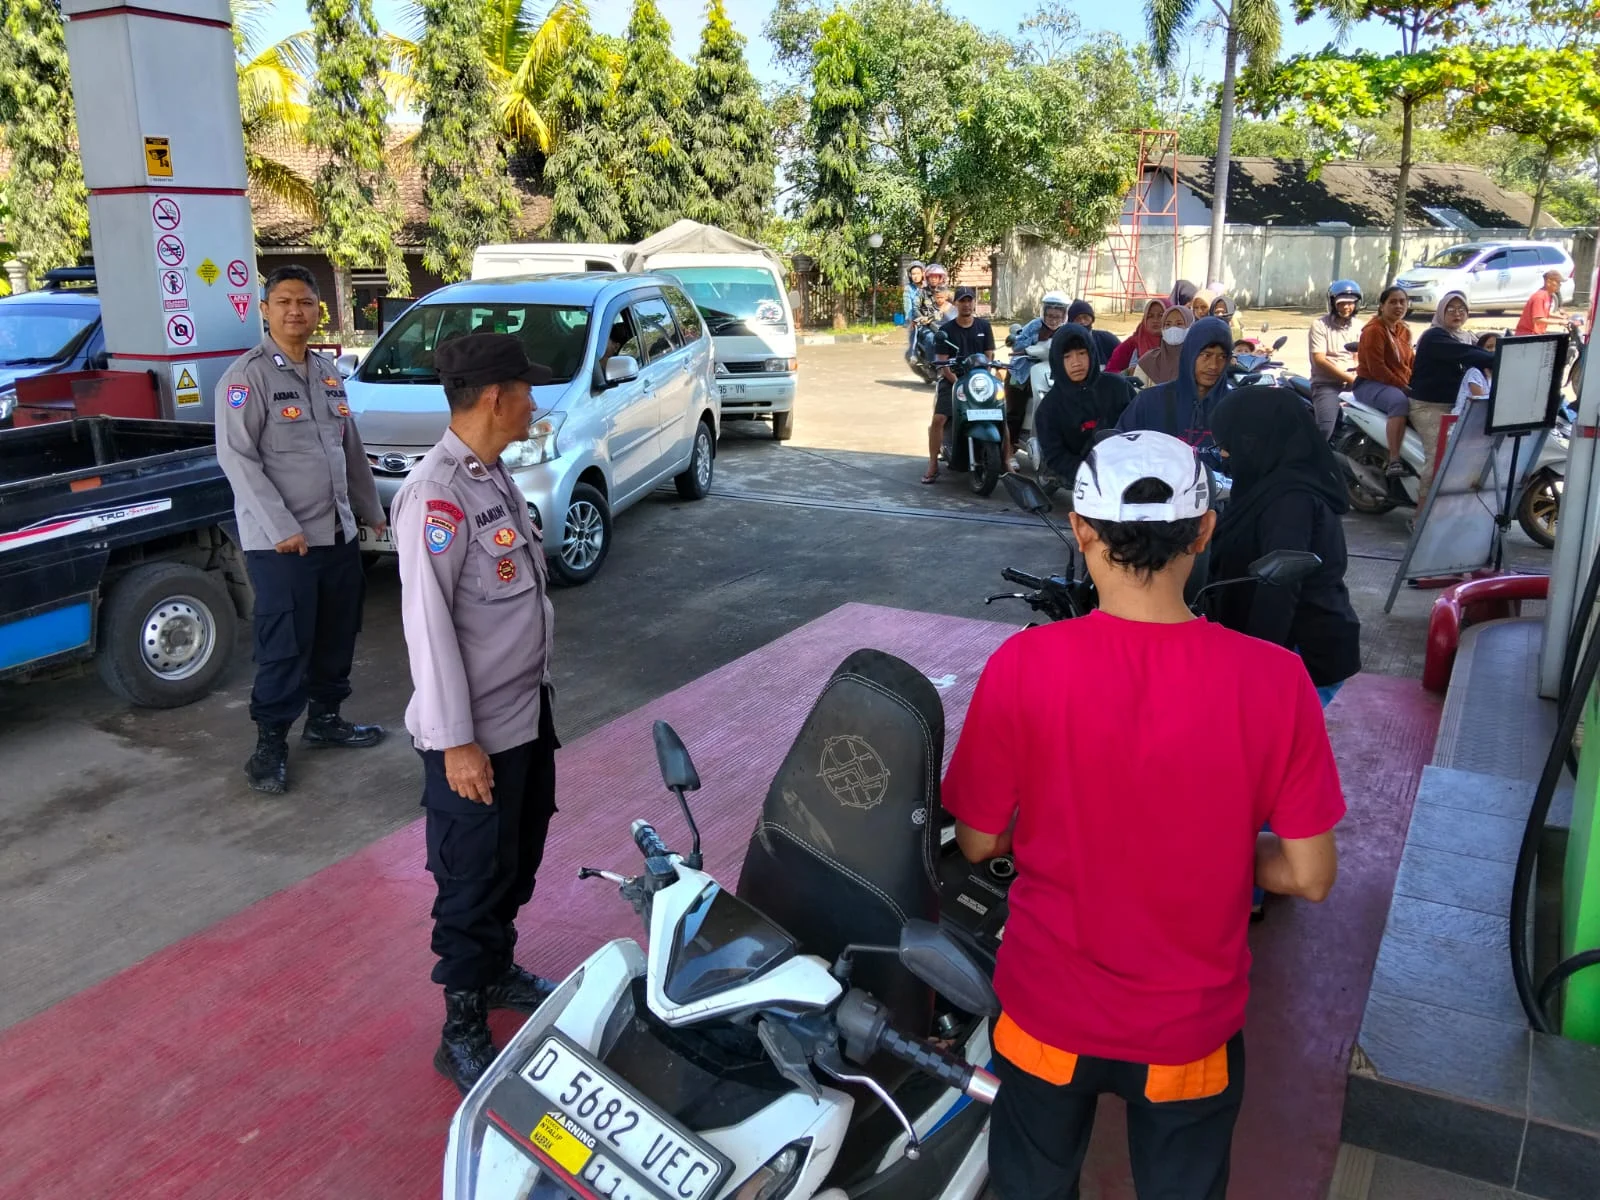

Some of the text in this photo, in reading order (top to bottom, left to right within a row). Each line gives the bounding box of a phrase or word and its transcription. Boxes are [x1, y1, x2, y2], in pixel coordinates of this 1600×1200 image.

[528, 1048, 709, 1198] D 5682 VEC
